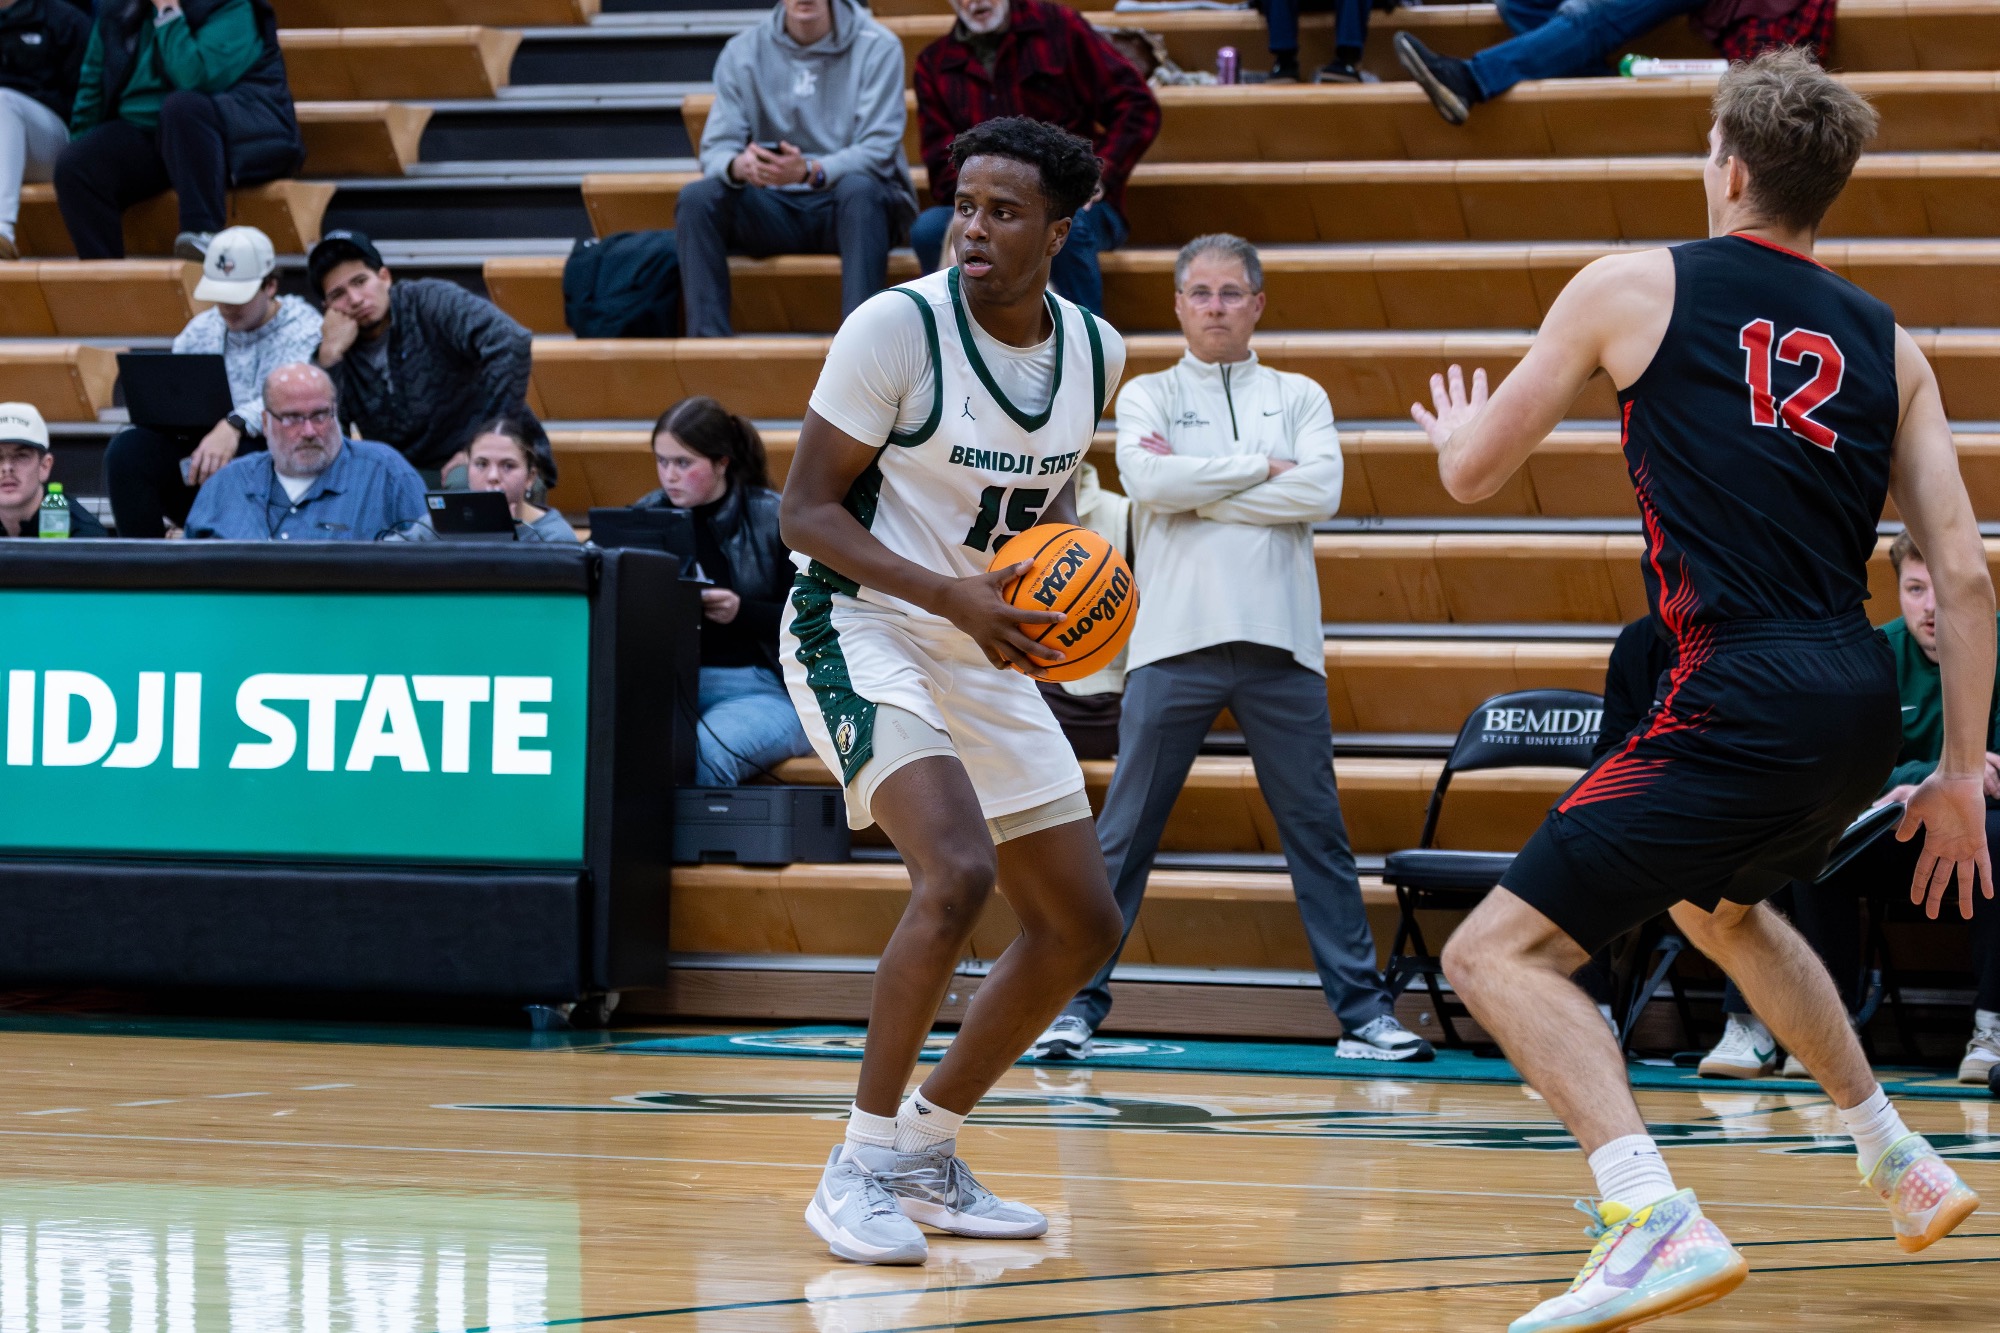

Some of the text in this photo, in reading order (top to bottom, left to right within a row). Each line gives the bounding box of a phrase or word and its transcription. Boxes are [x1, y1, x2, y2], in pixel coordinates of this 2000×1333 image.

[1739, 318, 1845, 453] 12
[949, 445, 1082, 476] BEMIDJI STATE
[962, 485, 1050, 554] 15
[1033, 542, 1092, 608] NCAA
[1056, 566, 1131, 648] Wilson
[0, 669, 553, 775] IDJI STATE
[1482, 734, 1600, 746] STATE UNIVERSITY
[1483, 708, 1604, 737] BEMIDJI
